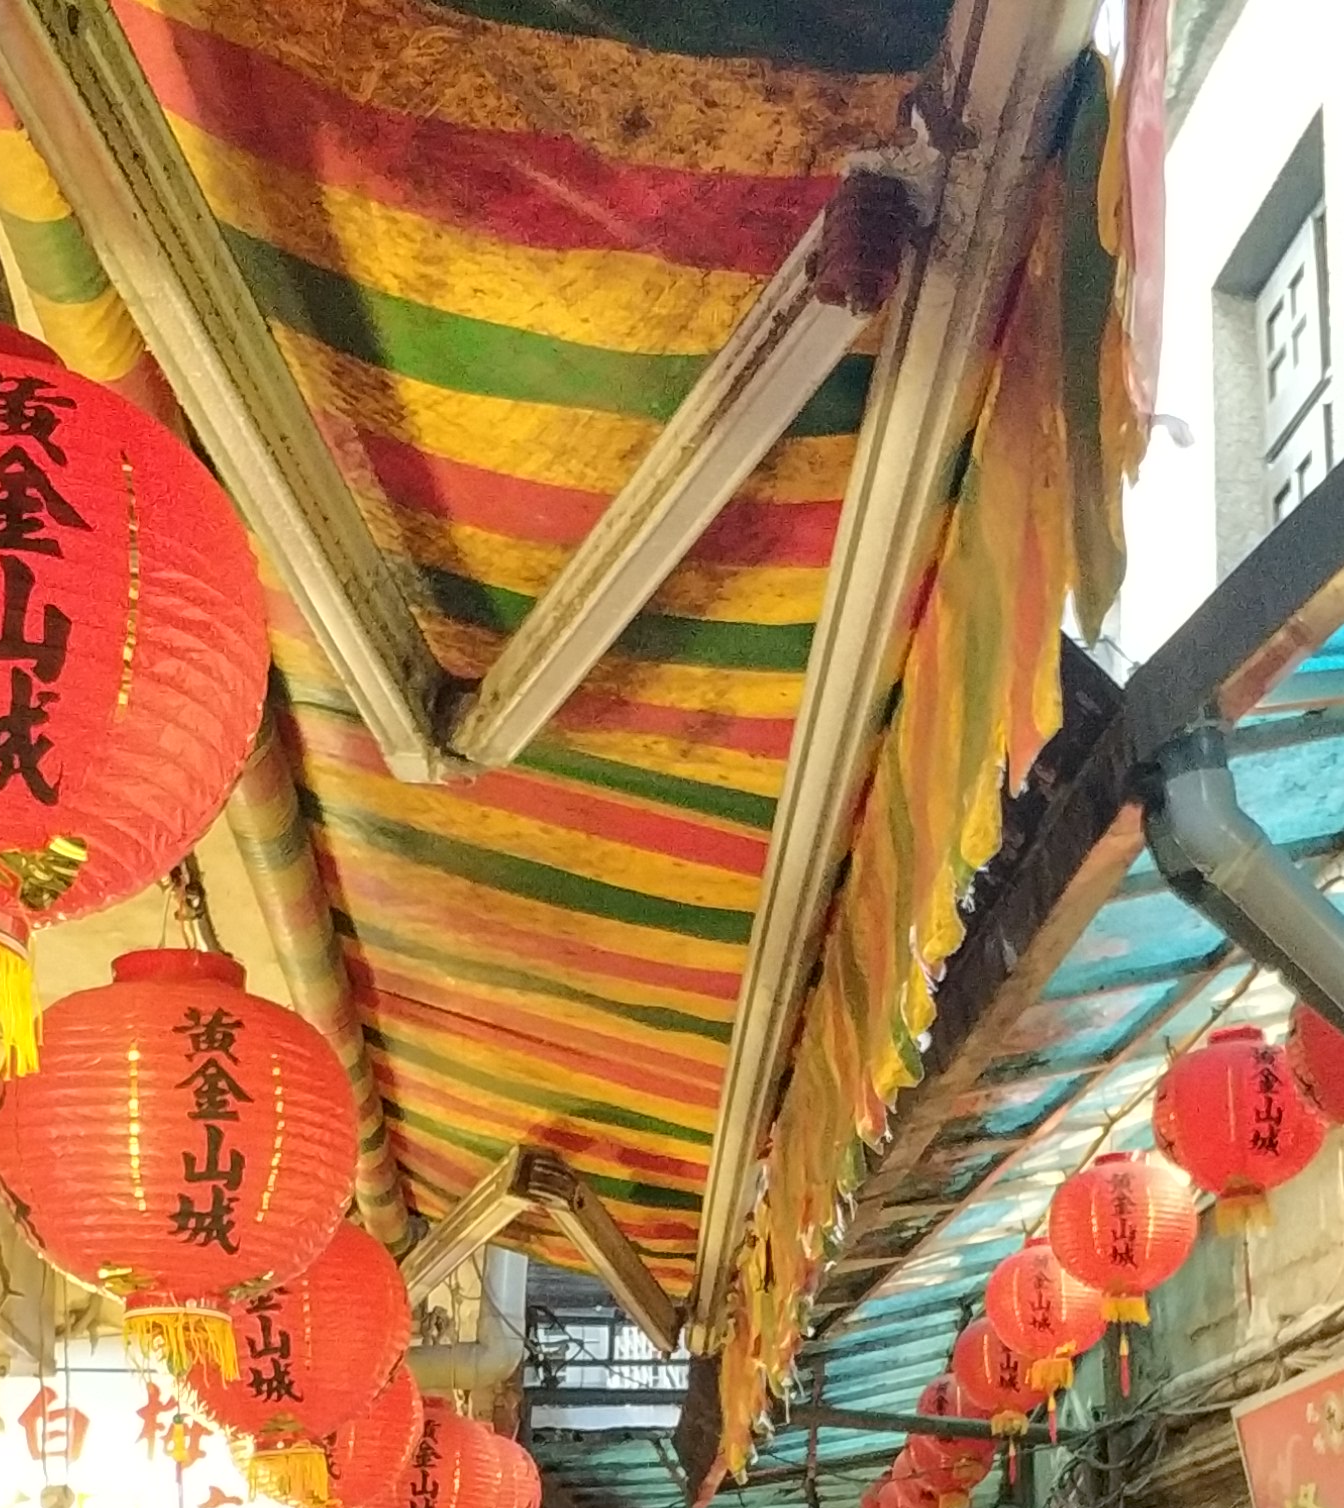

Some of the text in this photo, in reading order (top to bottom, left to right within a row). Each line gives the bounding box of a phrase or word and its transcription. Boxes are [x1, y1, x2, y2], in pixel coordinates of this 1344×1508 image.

[168, 1006, 254, 1255] 黃金山城
[1106, 1173, 1138, 1269] 黃金山城
